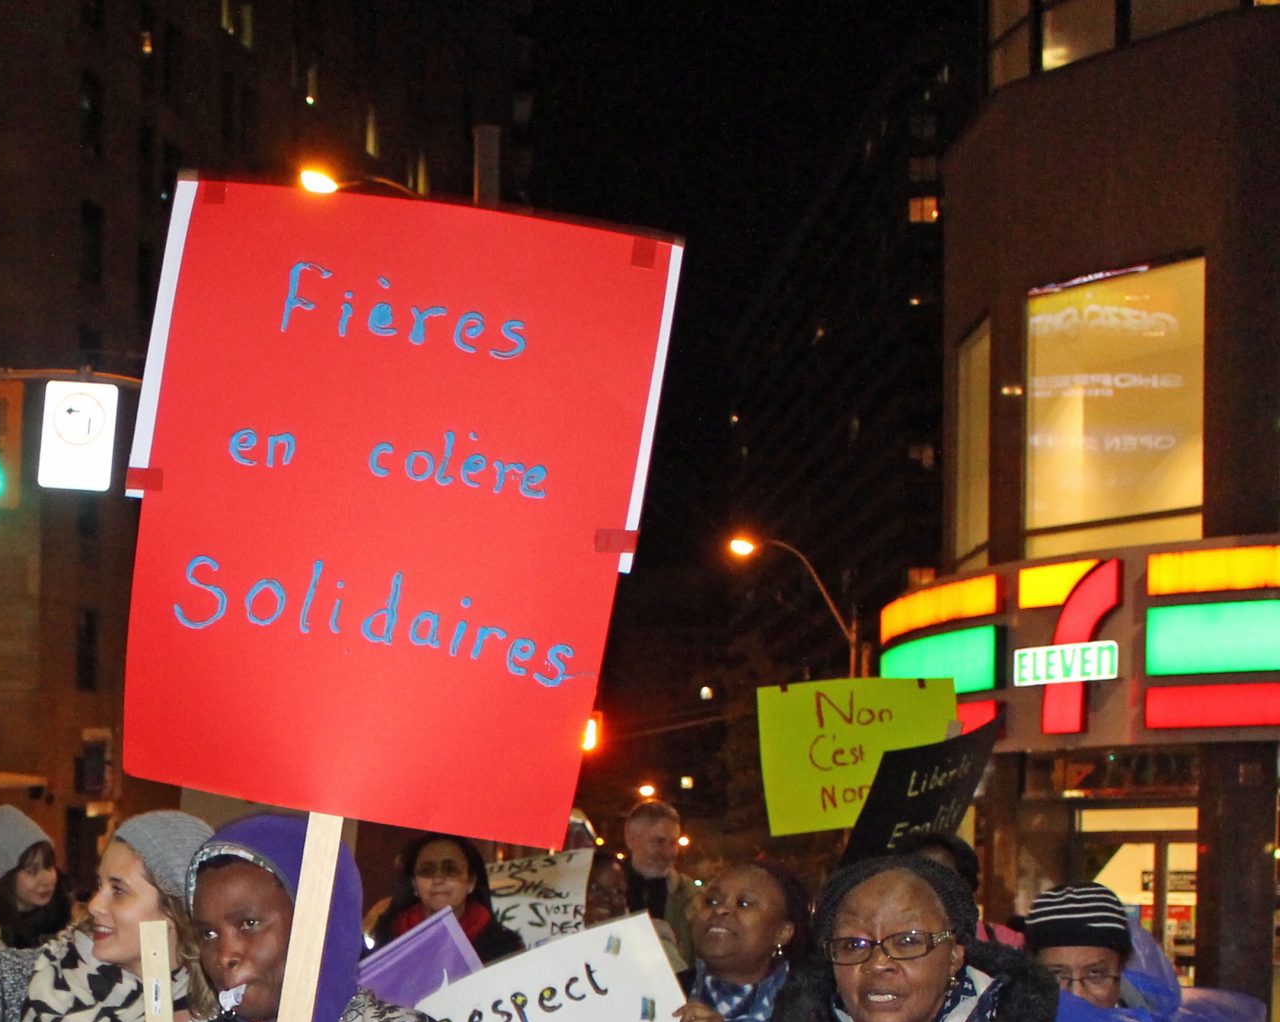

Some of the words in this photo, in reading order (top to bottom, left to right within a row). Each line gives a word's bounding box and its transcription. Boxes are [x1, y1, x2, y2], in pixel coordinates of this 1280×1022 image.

[281, 261, 527, 360] Fières
[229, 428, 296, 468] en
[369, 430, 547, 499] colère
[173, 555, 575, 687] Solidaires
[1019, 557, 1119, 735] 7
[815, 690, 893, 729] Non
